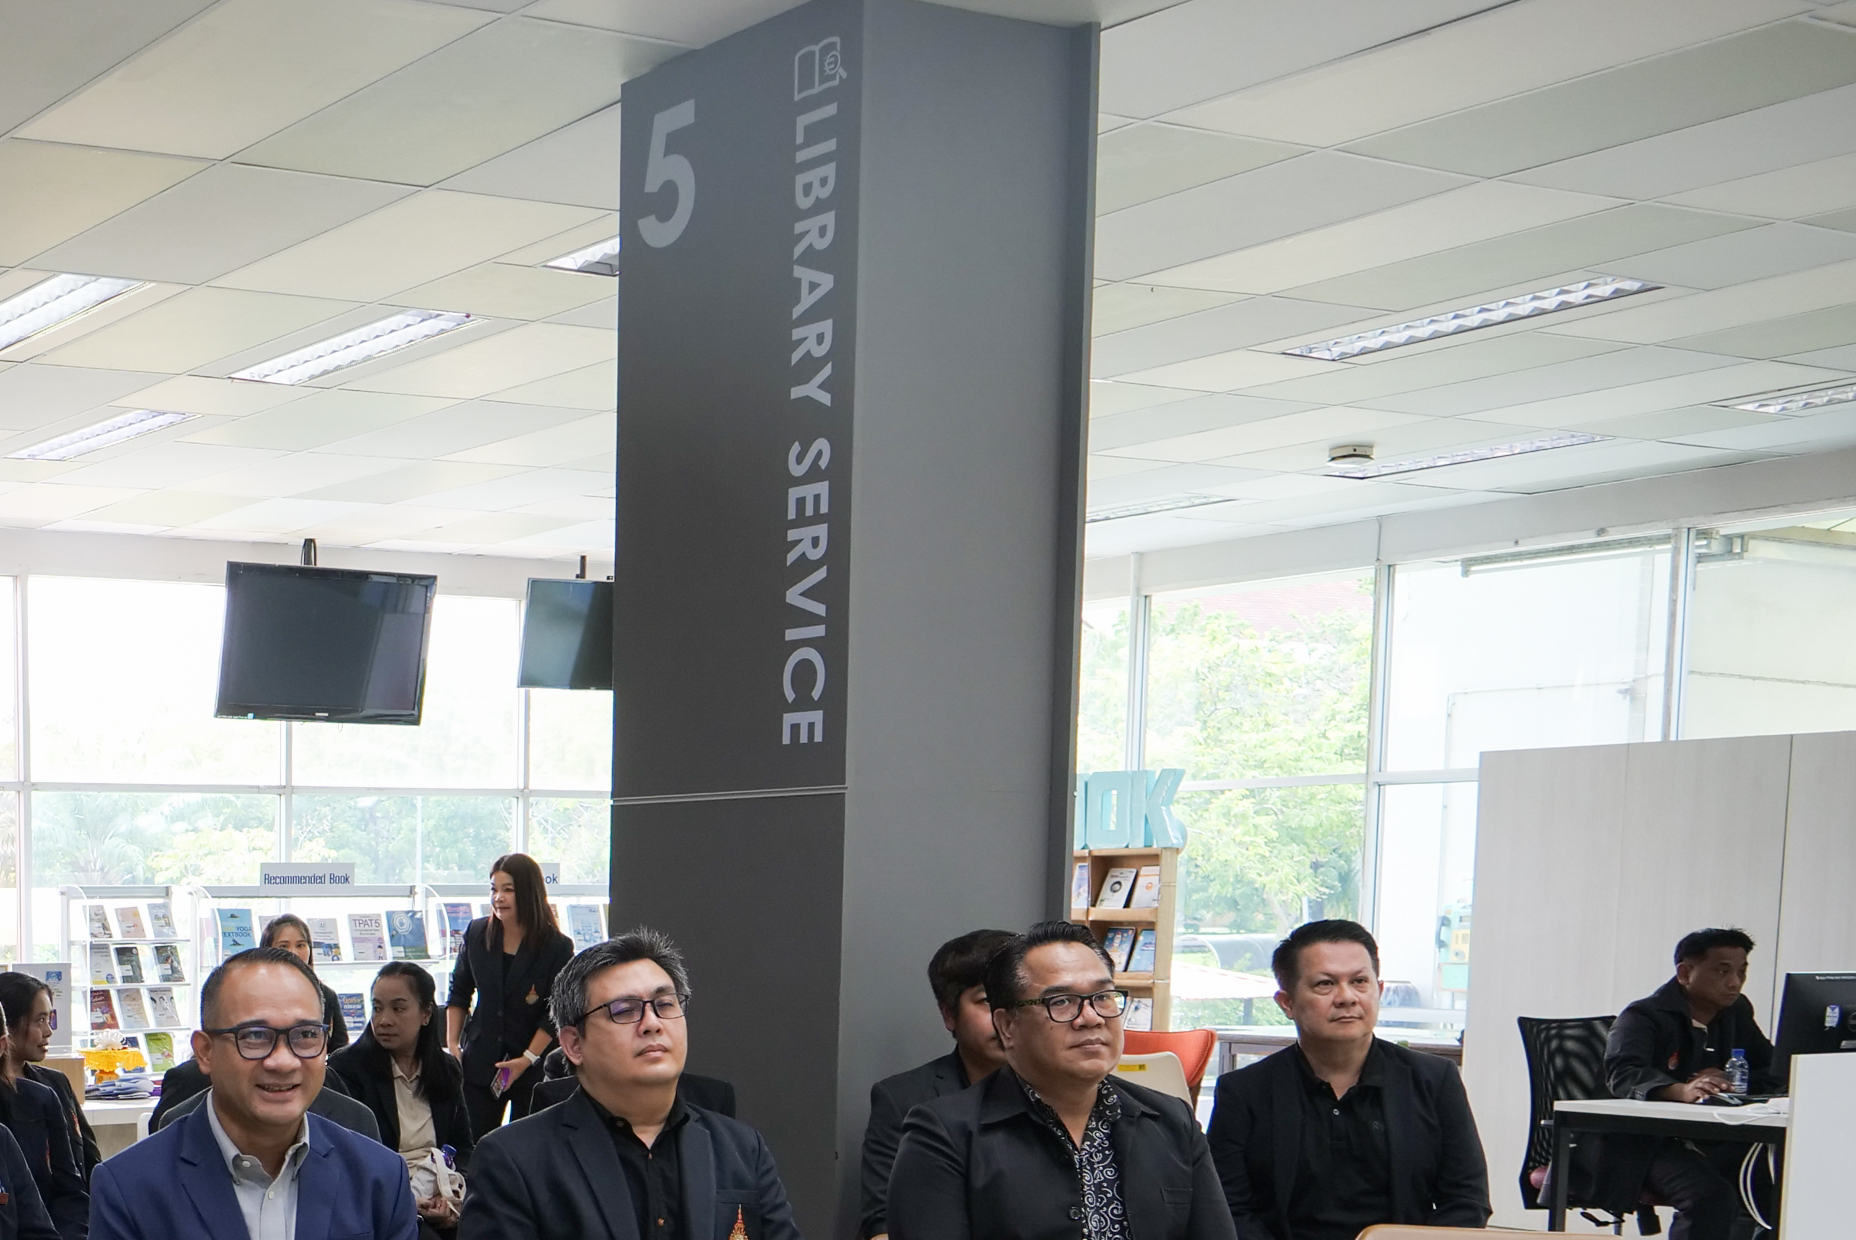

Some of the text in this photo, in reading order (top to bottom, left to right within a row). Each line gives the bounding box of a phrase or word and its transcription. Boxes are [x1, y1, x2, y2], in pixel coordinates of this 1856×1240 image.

[637, 98, 696, 249] 5
[782, 102, 839, 745] LIBRARY SERVICE
[1074, 768, 1186, 850] OK
[264, 873, 350, 885] Recommended Book
